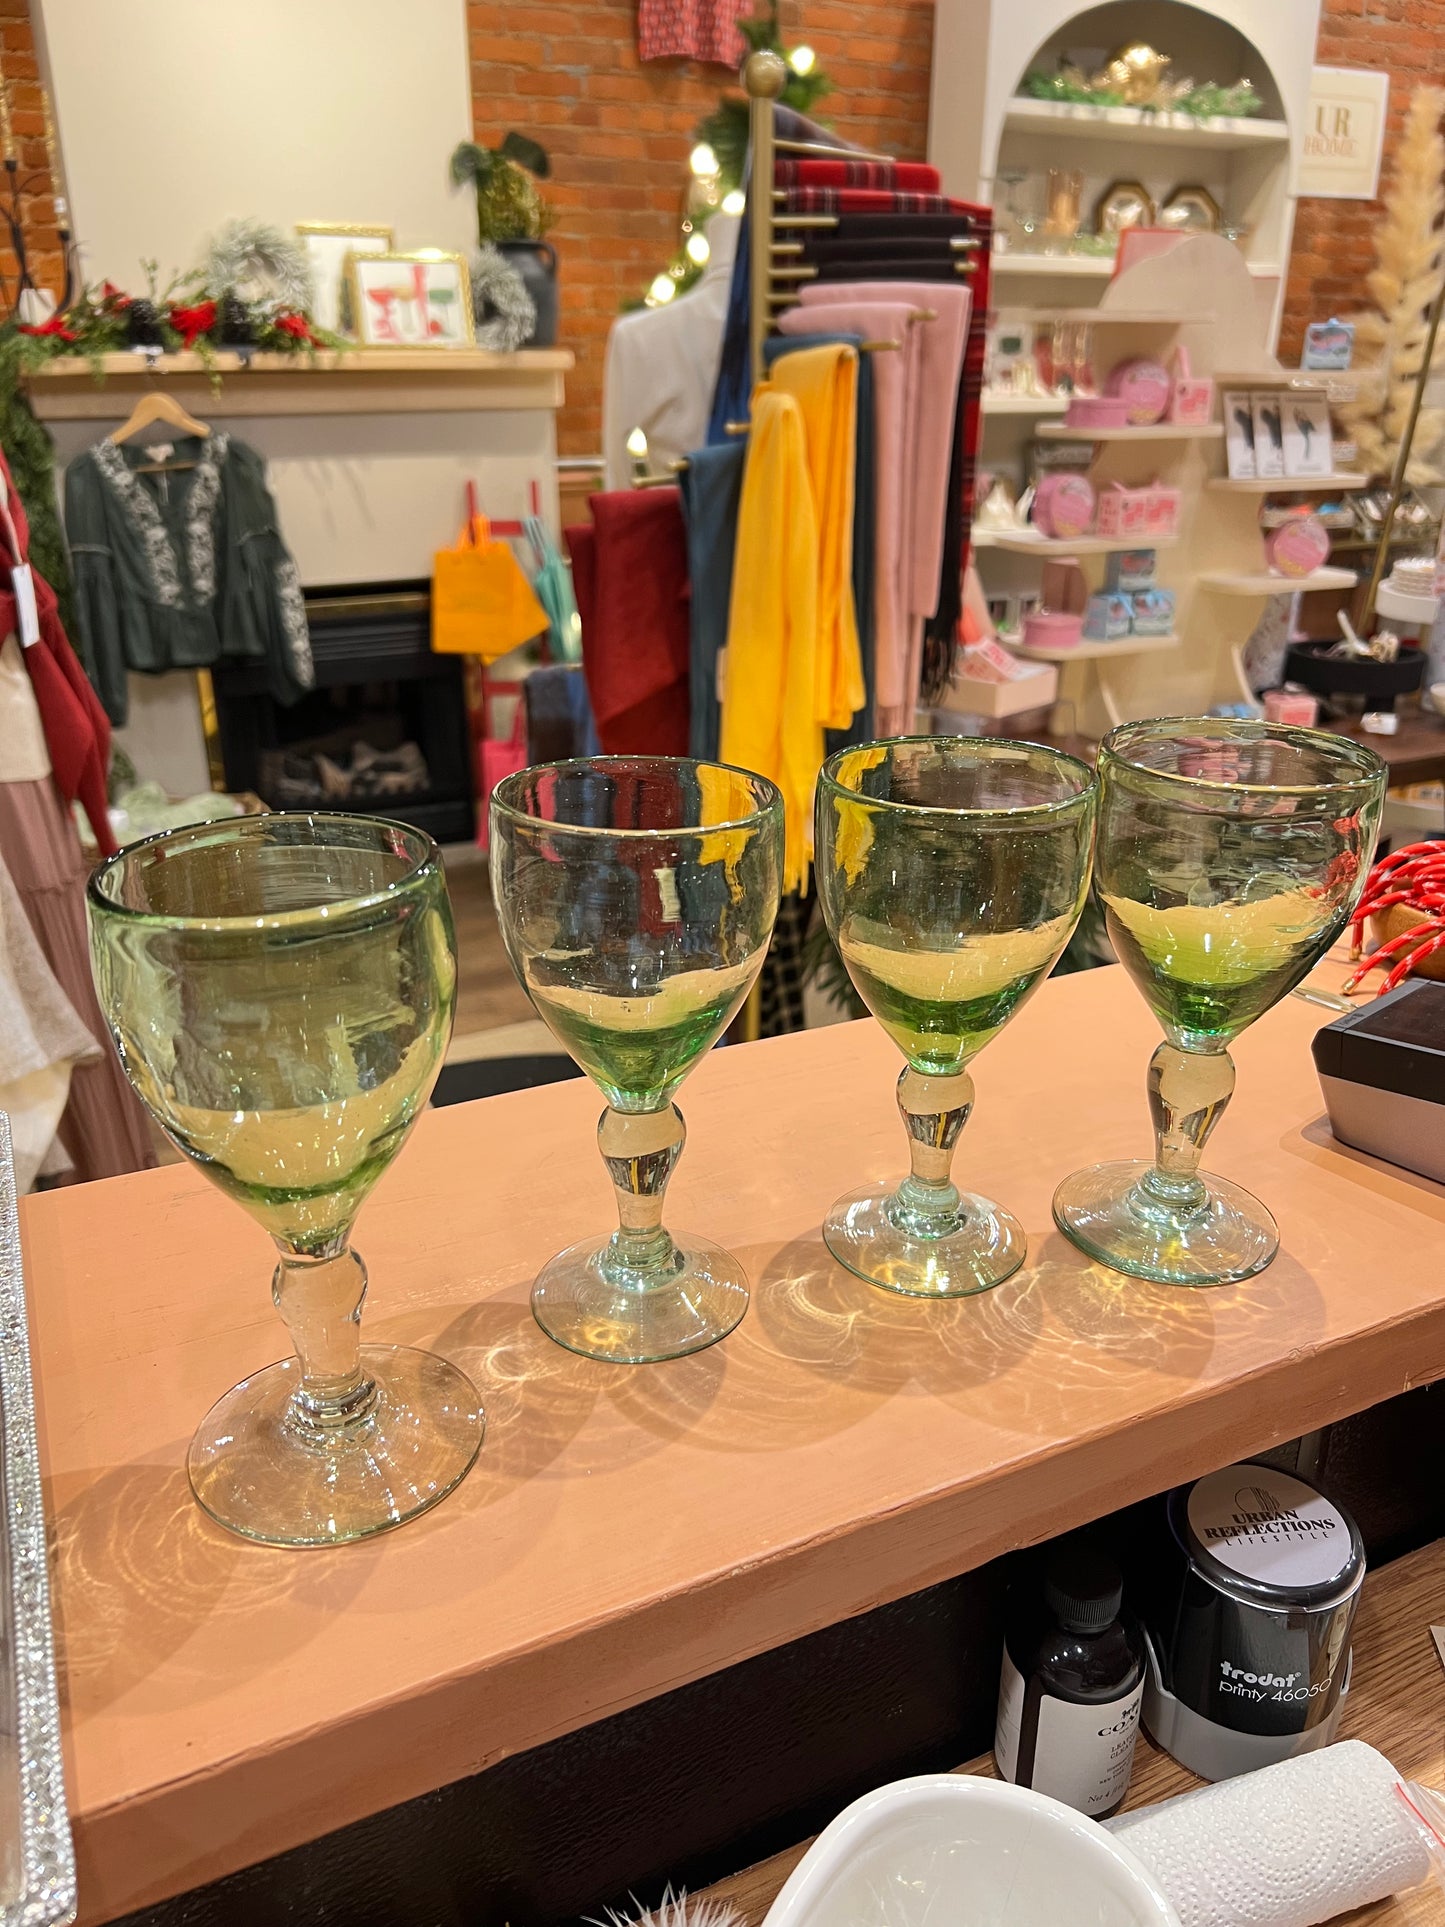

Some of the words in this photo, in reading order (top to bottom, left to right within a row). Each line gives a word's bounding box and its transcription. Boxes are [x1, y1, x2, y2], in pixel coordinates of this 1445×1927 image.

[1232, 1509, 1299, 1524] URBAN
[1204, 1518, 1336, 1539] REFLECTIONS
[1225, 1531, 1329, 1546] LIFESTYLE
[1219, 1680, 1267, 1702] printy
[1271, 1678, 1332, 1702] 46050
